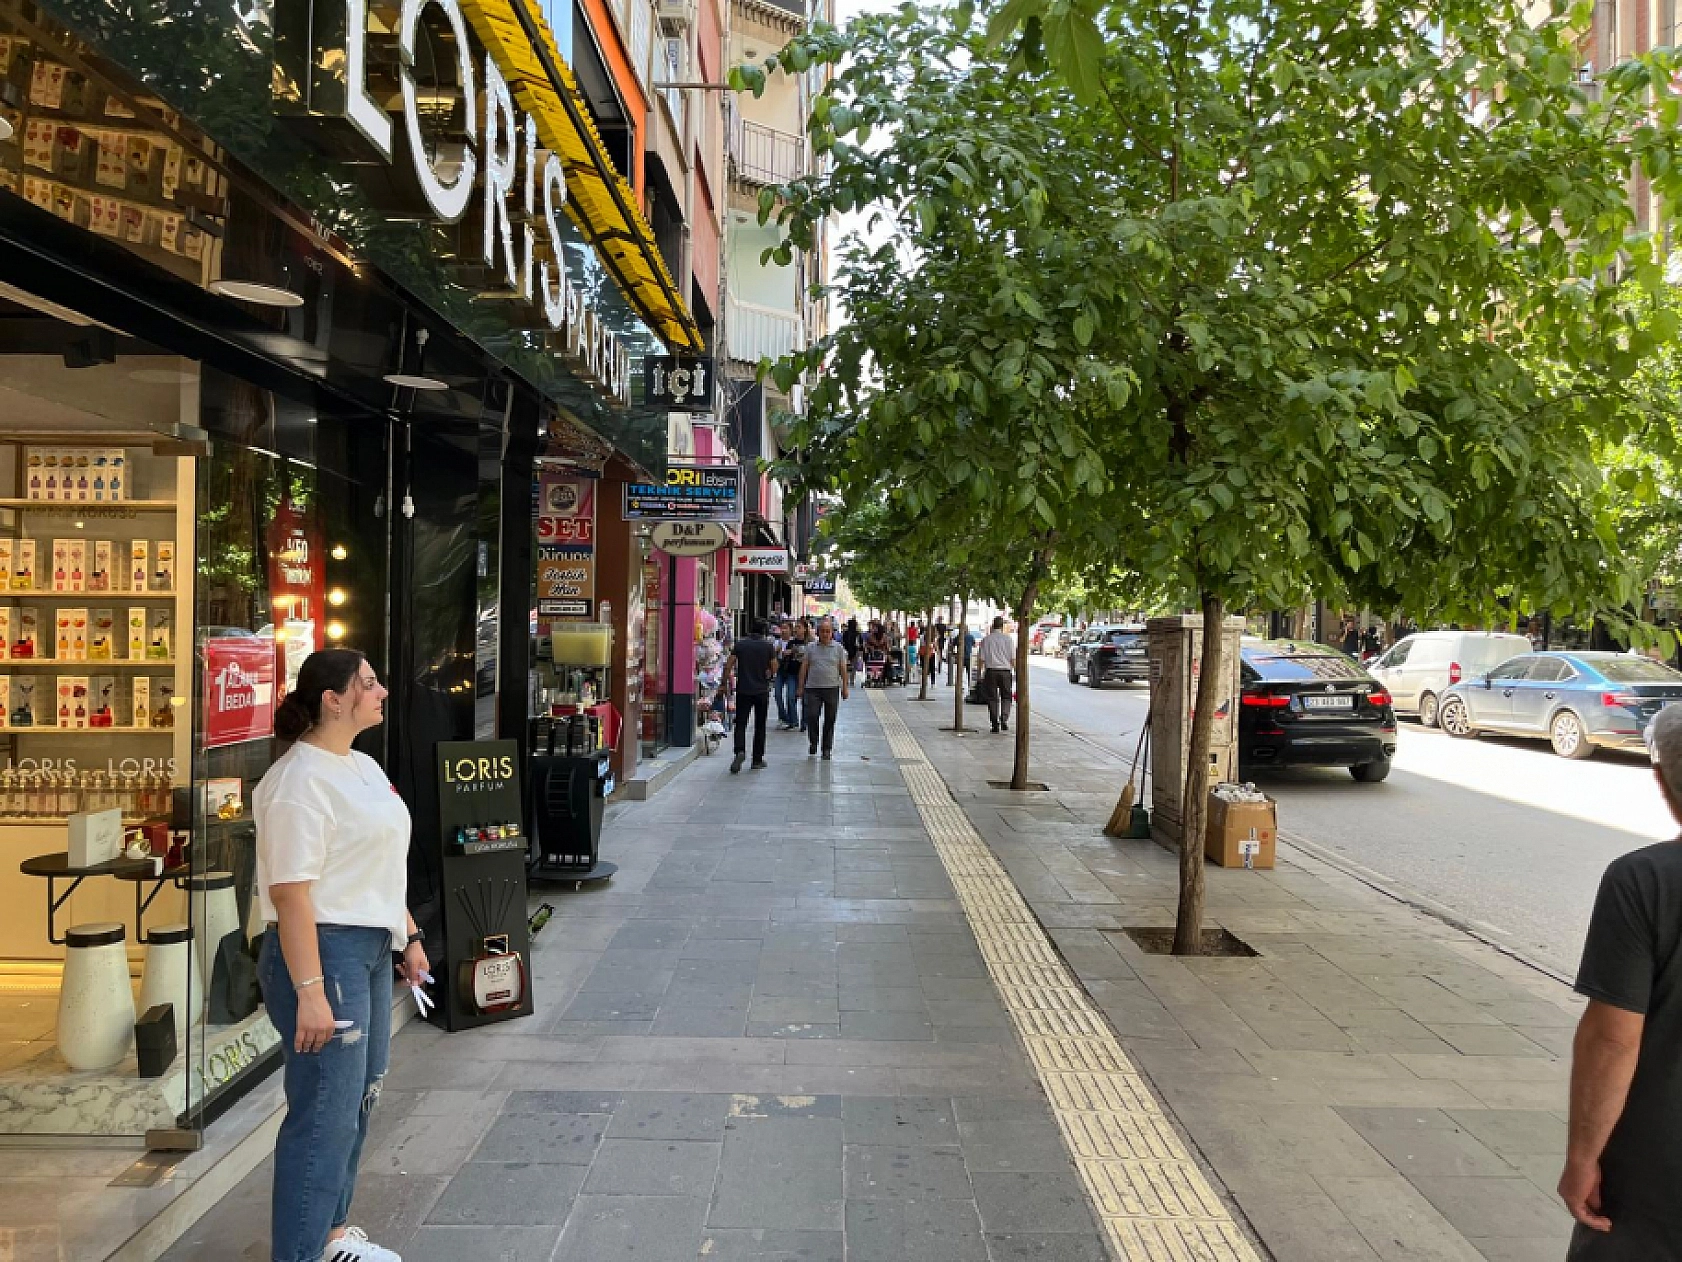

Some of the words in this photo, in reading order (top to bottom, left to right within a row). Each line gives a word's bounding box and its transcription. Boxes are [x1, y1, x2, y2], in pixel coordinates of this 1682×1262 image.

[346, 0, 567, 330] LORIS
[538, 516, 593, 539] SET
[673, 523, 705, 536] D&P
[7, 757, 77, 778] LORIS
[108, 757, 179, 778] LORIS
[444, 755, 513, 783] LORIS
[456, 781, 504, 794] PARFUM
